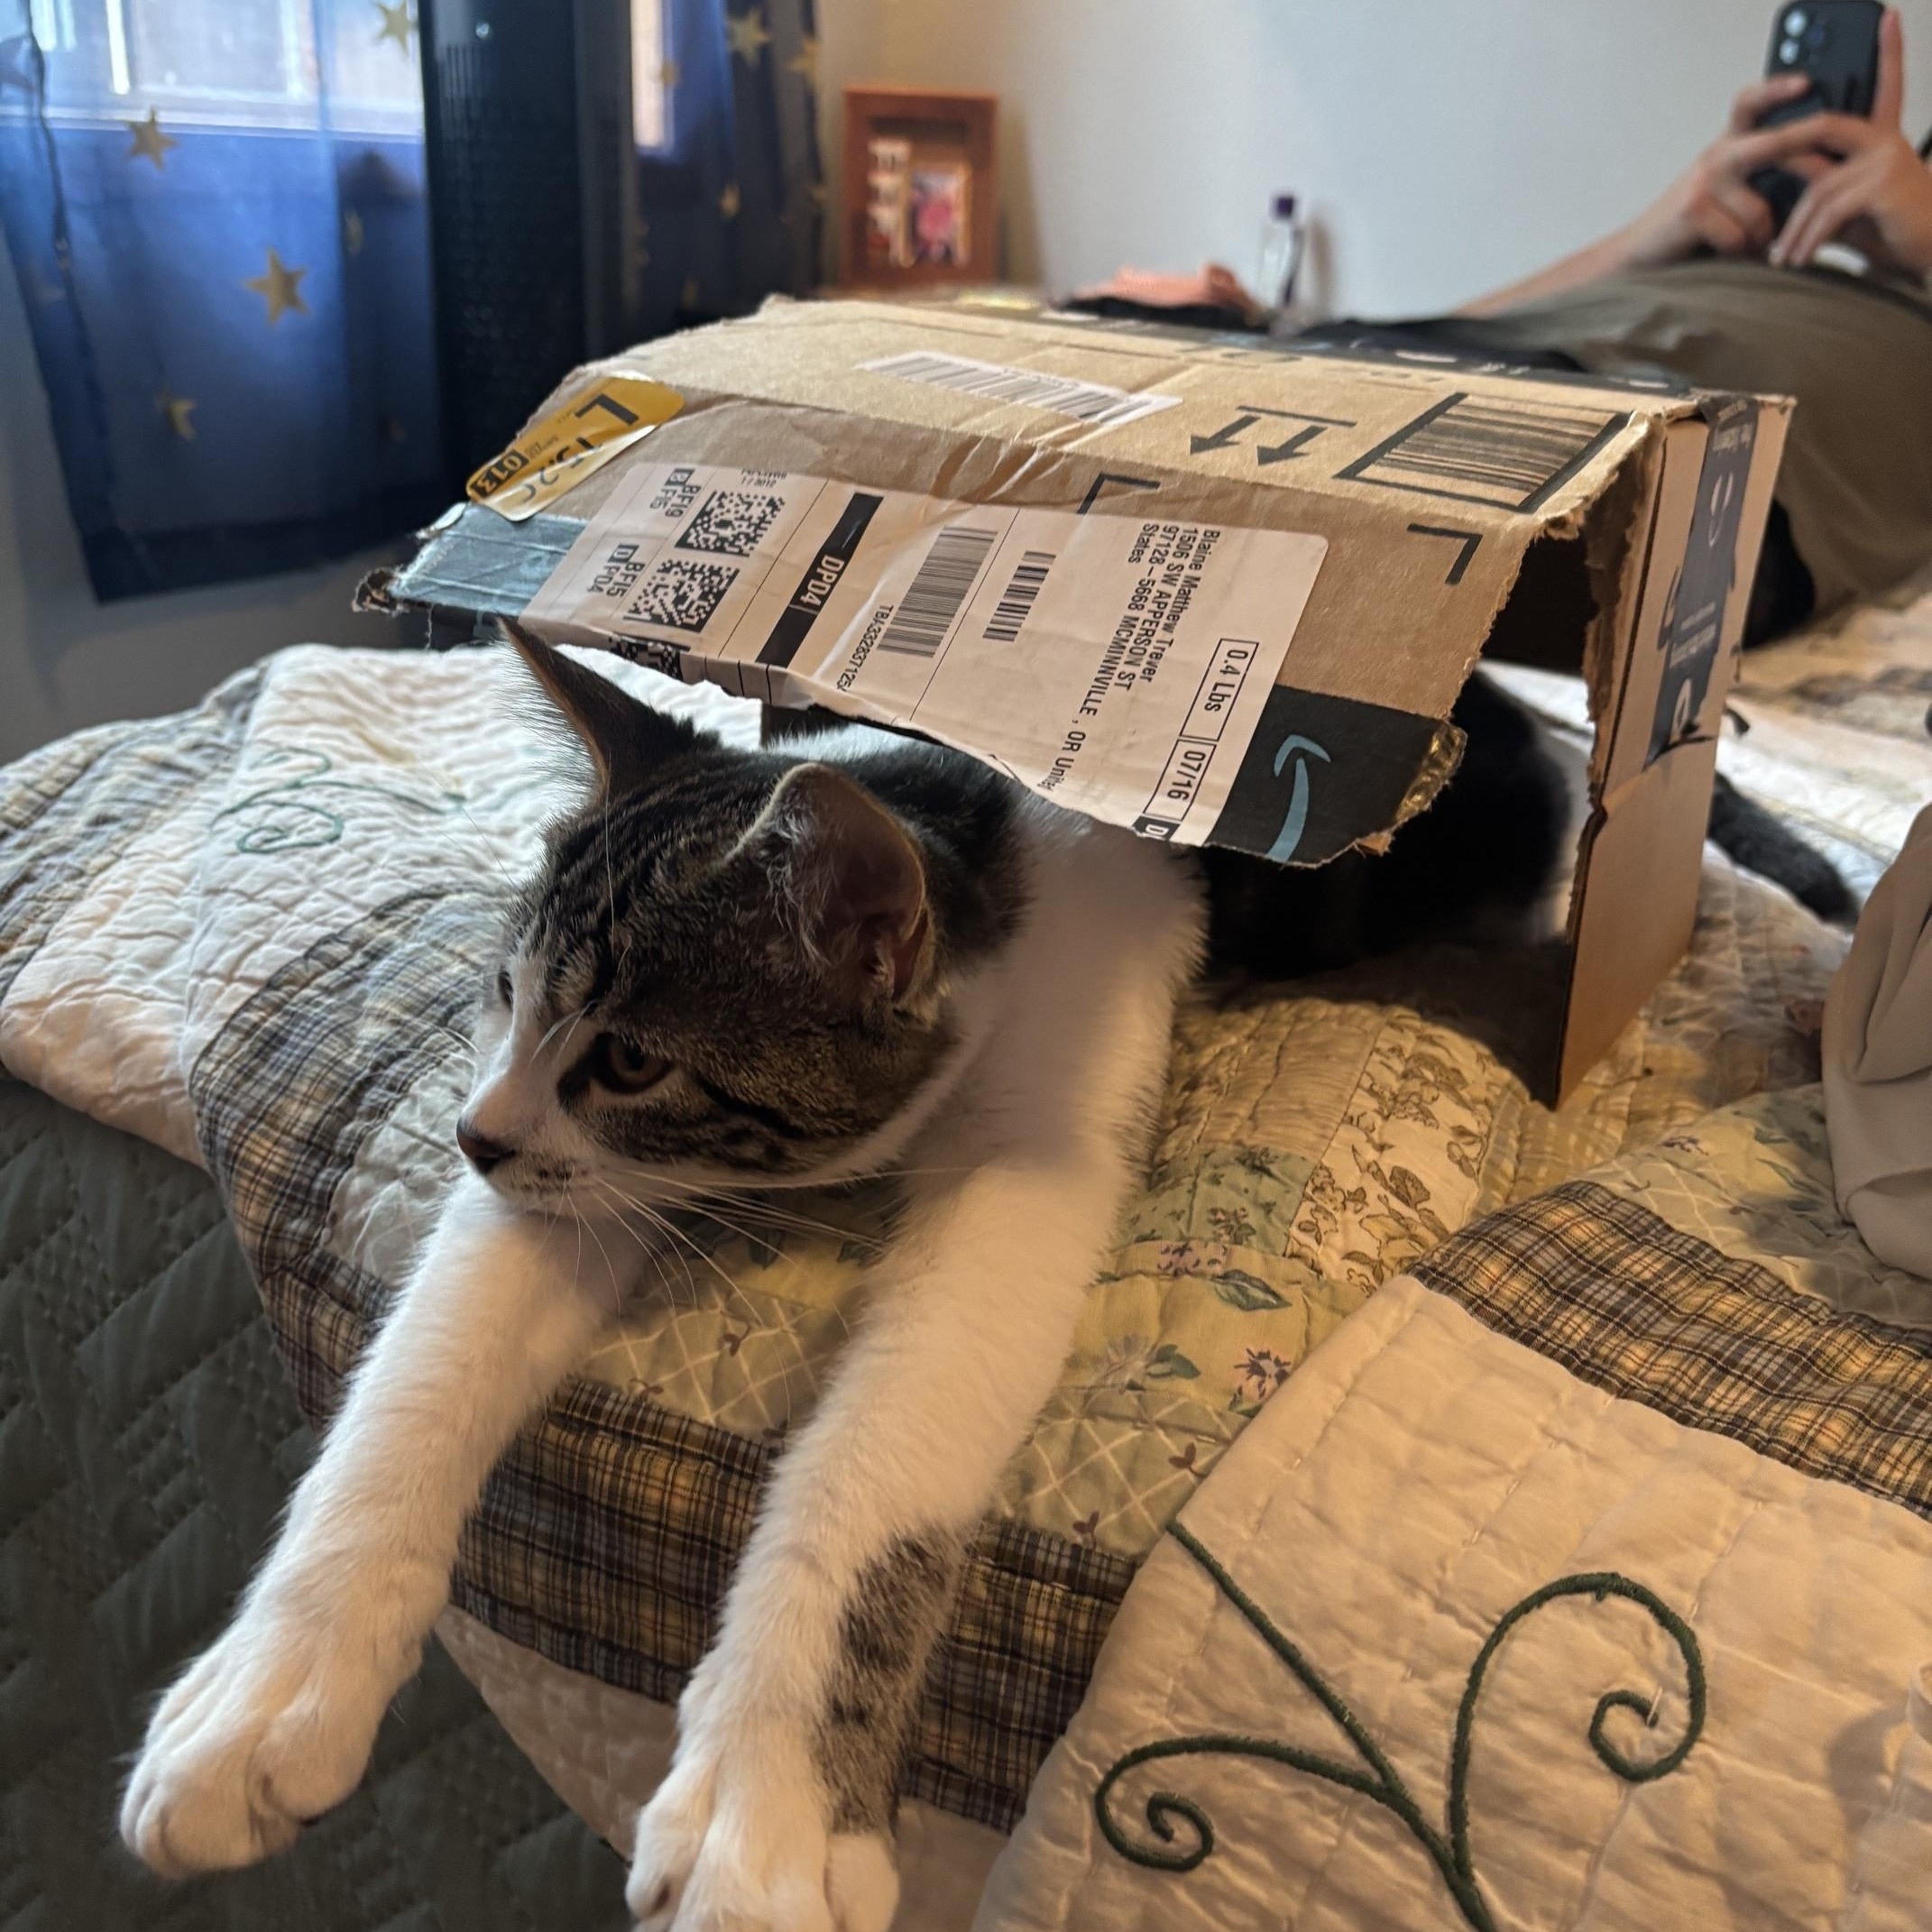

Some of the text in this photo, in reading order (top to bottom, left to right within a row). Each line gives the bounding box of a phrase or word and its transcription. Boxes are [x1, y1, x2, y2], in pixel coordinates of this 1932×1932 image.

[575, 394, 639, 426] L
[476, 455, 523, 492] 013
[1128, 523, 1160, 564] States
[1114, 528, 1199, 692] 1506 SW APPERSON ST
[1139, 529, 1221, 683] Blaine Matthew Trever
[1079, 615, 1140, 716] MCMINNVILLE
[1204, 649, 1249, 713] 0.4 Lbs
[1062, 731, 1087, 752] OR
[1167, 750, 1206, 801] 07/16
[1145, 823, 1170, 841] D
